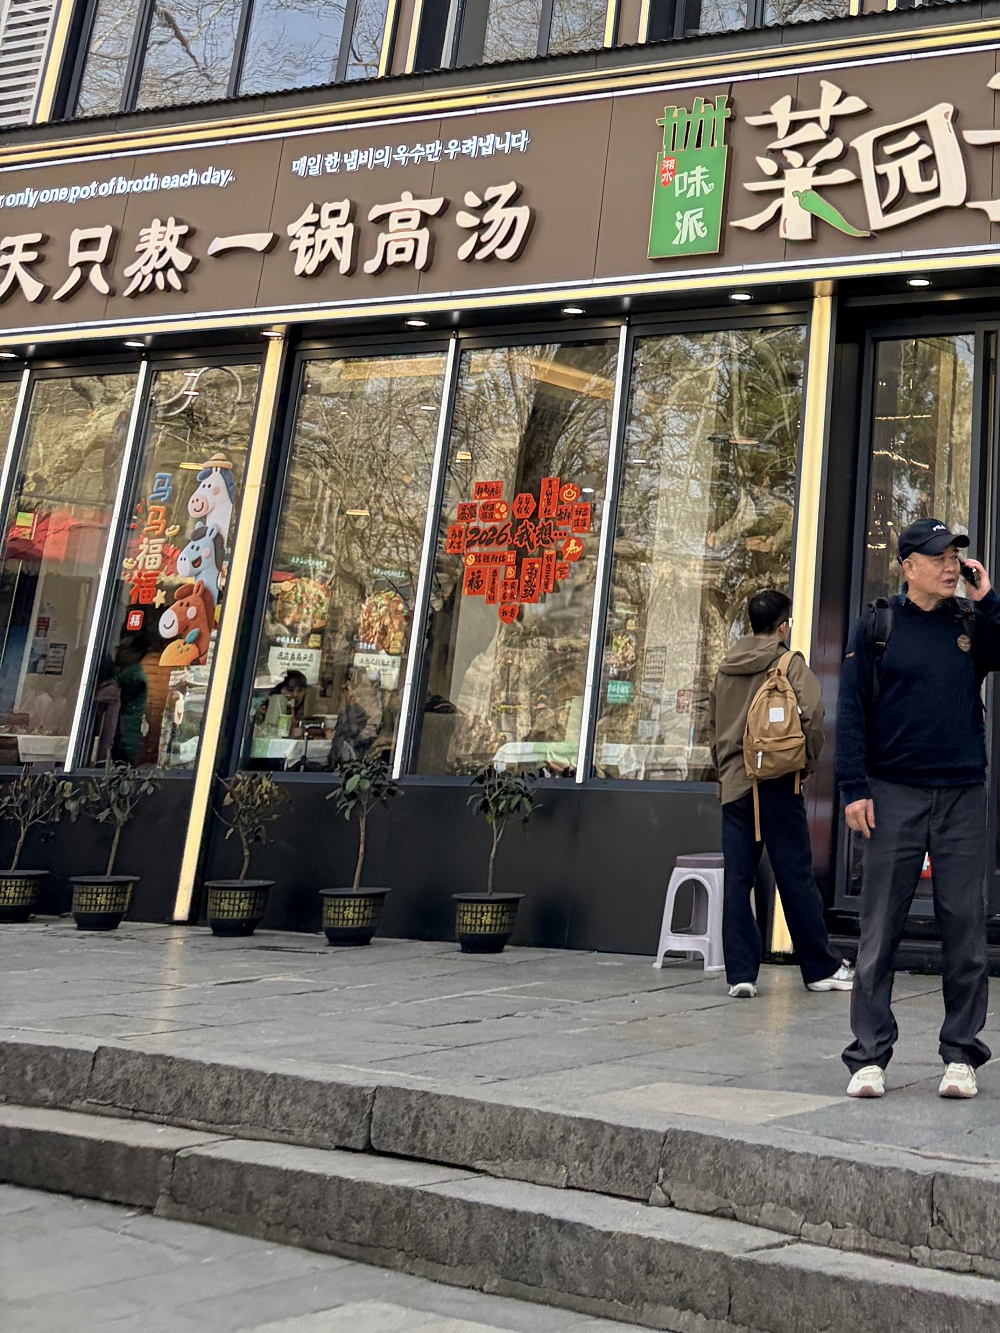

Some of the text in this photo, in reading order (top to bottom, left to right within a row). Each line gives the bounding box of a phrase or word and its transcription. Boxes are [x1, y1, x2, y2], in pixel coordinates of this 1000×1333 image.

[291, 152, 323, 177] 매일
[324, 151, 341, 174] 한
[661, 158, 676, 183] 湘水
[5, 187, 39, 208] only
[40, 184, 68, 203] one
[68, 180, 99, 204] pot
[100, 176, 117, 197] of
[116, 172, 161, 194] broth
[161, 167, 200, 189] each
[671, 164, 715, 245] 味派
[0, 181, 531, 302] 天只熬一锅高汤
[467, 569, 485, 593] 福
